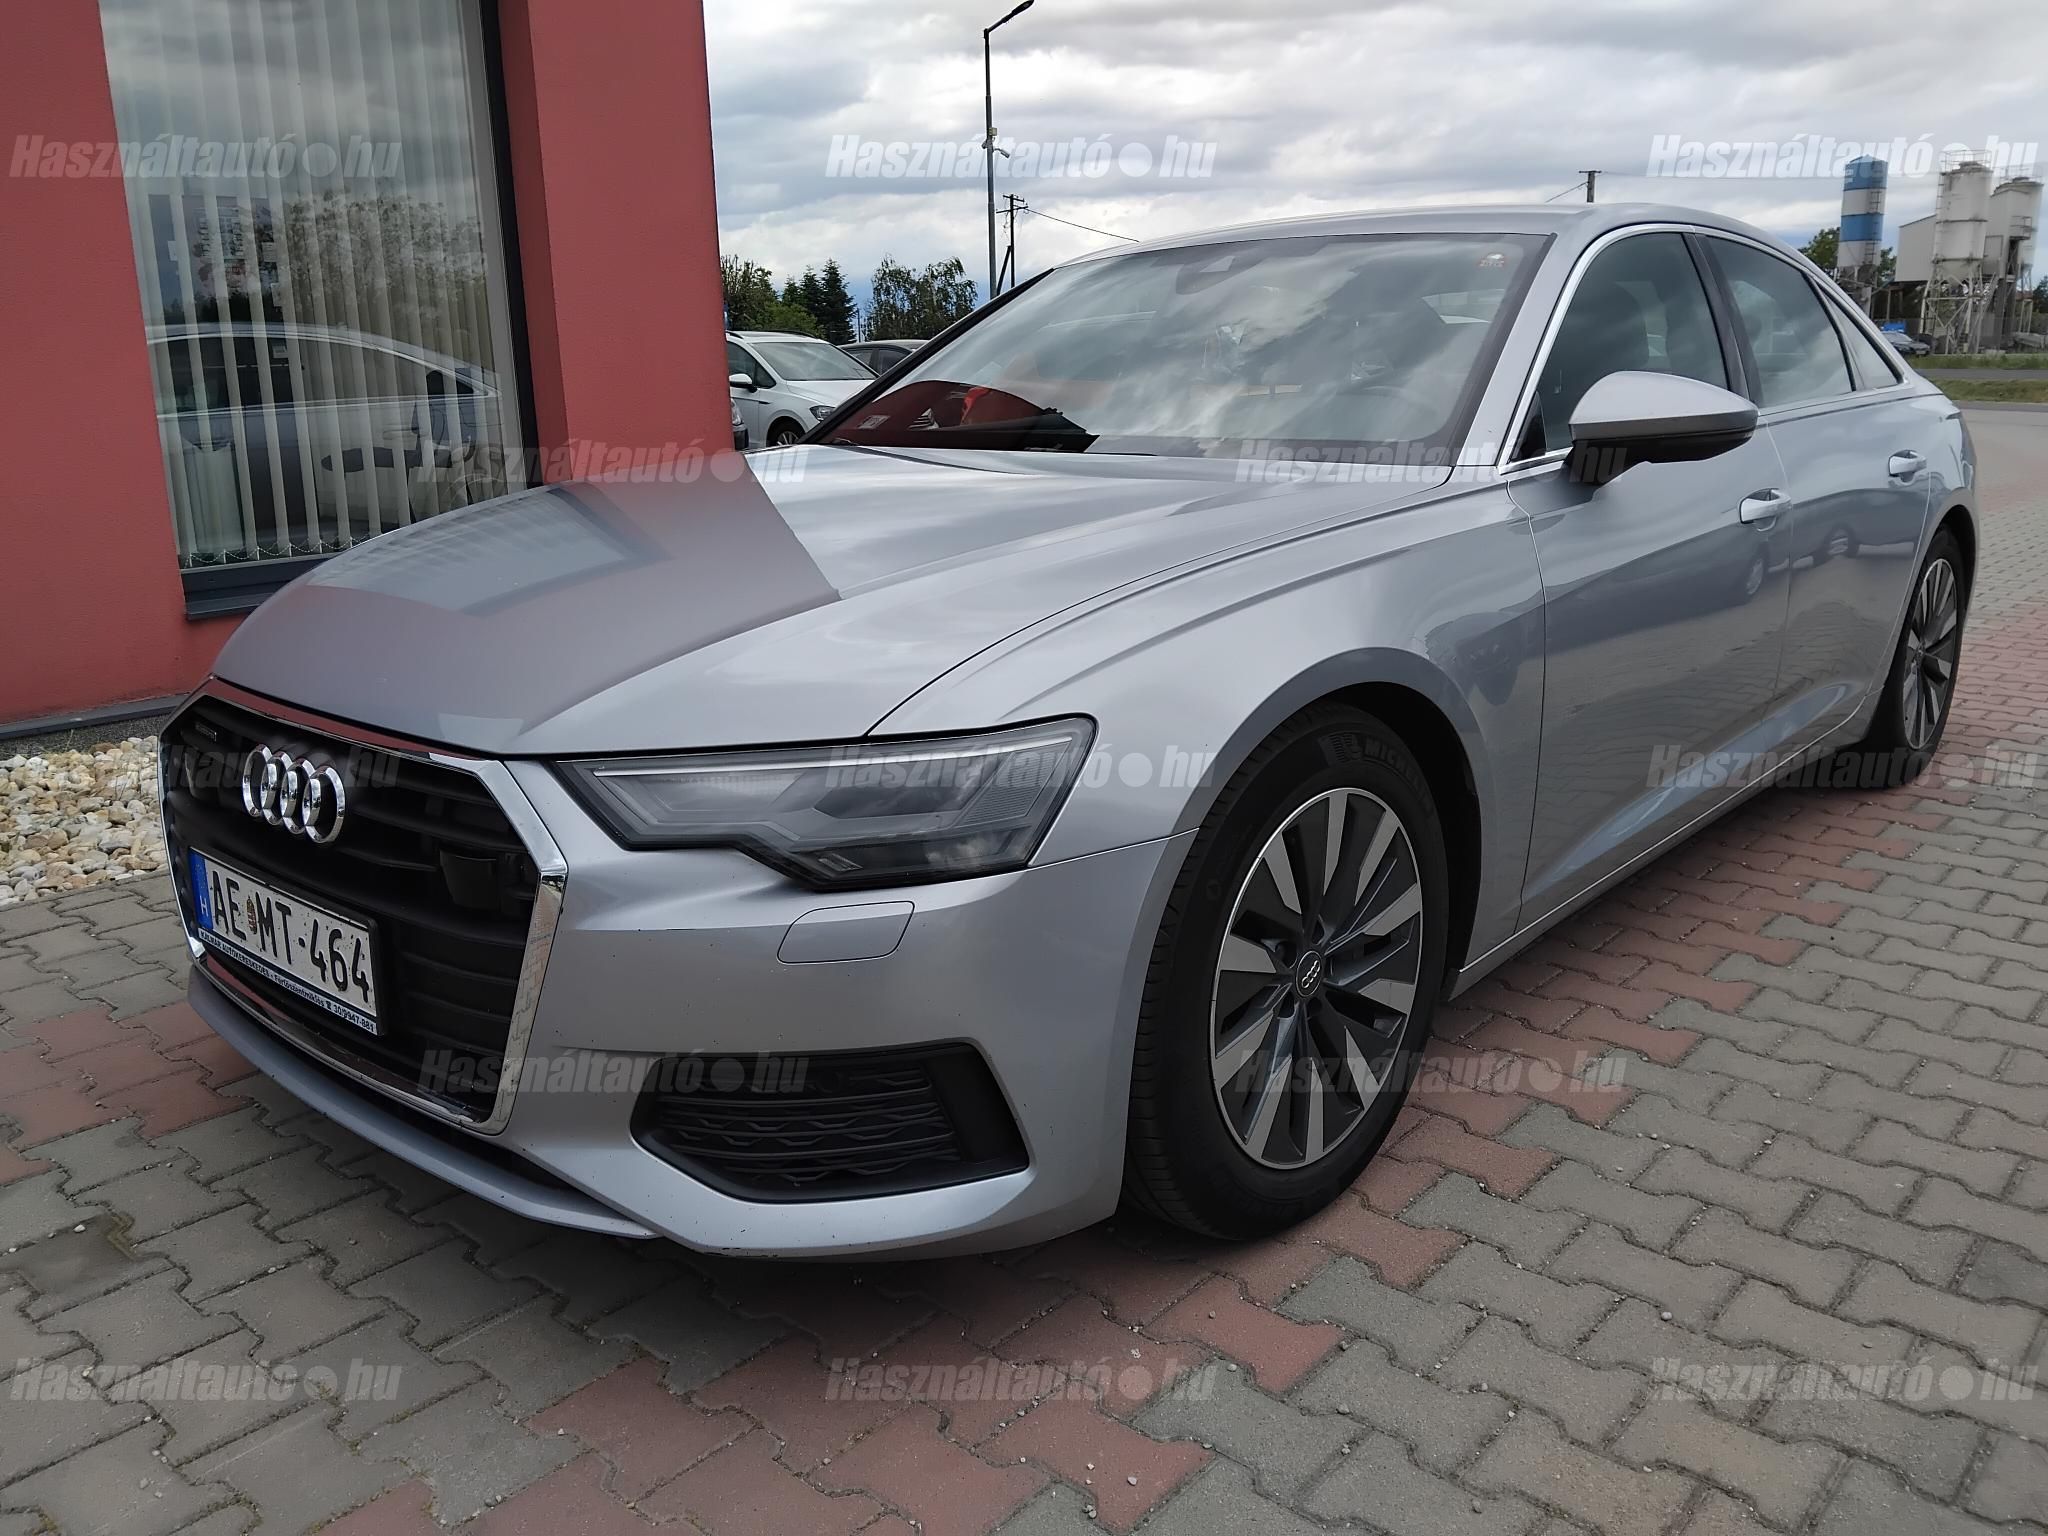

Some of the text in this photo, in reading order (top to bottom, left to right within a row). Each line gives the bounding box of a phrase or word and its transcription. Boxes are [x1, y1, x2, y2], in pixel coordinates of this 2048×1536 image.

[199, 896, 209, 918] H
[211, 870, 370, 1003] AE MT-464
